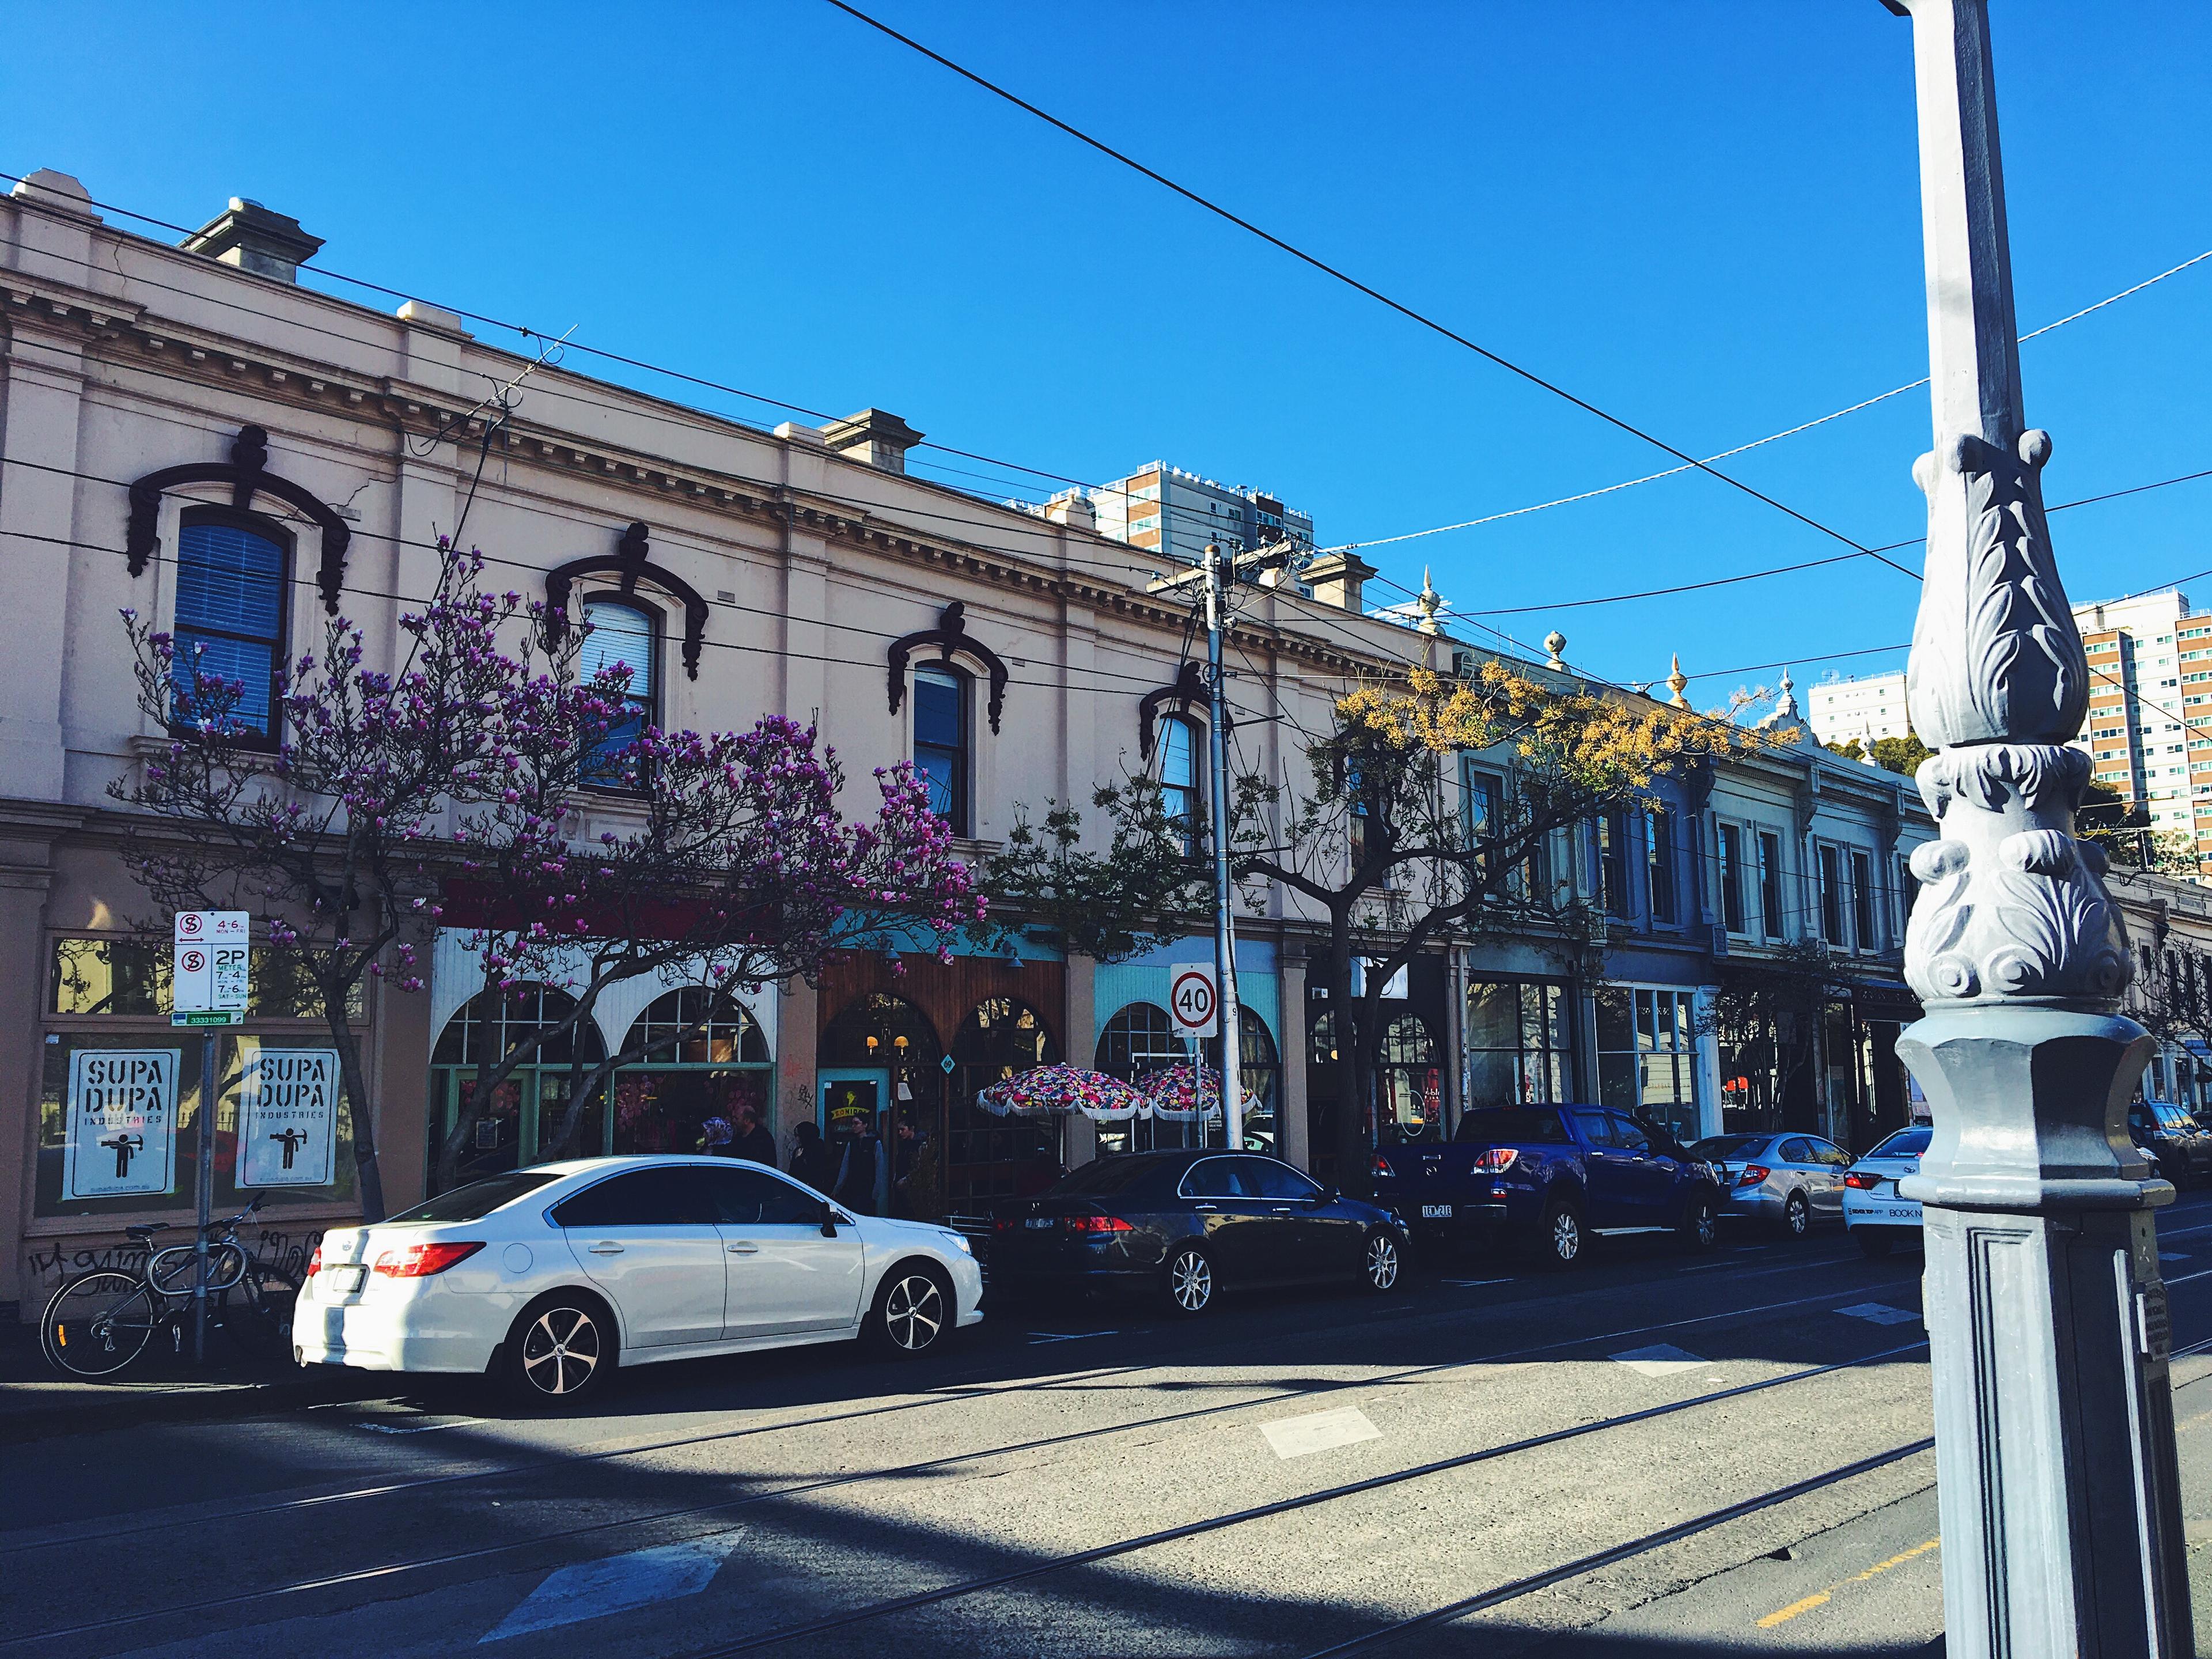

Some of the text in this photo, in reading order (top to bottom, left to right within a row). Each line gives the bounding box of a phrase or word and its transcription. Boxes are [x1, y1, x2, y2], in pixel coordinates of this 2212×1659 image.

[216, 950, 245, 965] 2P
[1179, 988, 1208, 1013] 40
[88, 1060, 162, 1085] SUPA
[260, 1058, 325, 1082] SUPA
[944, 1060, 952, 1068] 69
[86, 1087, 162, 1113] DUPA
[257, 1084, 324, 1107] DUPA
[84, 1115, 162, 1126] INDUSTRIES
